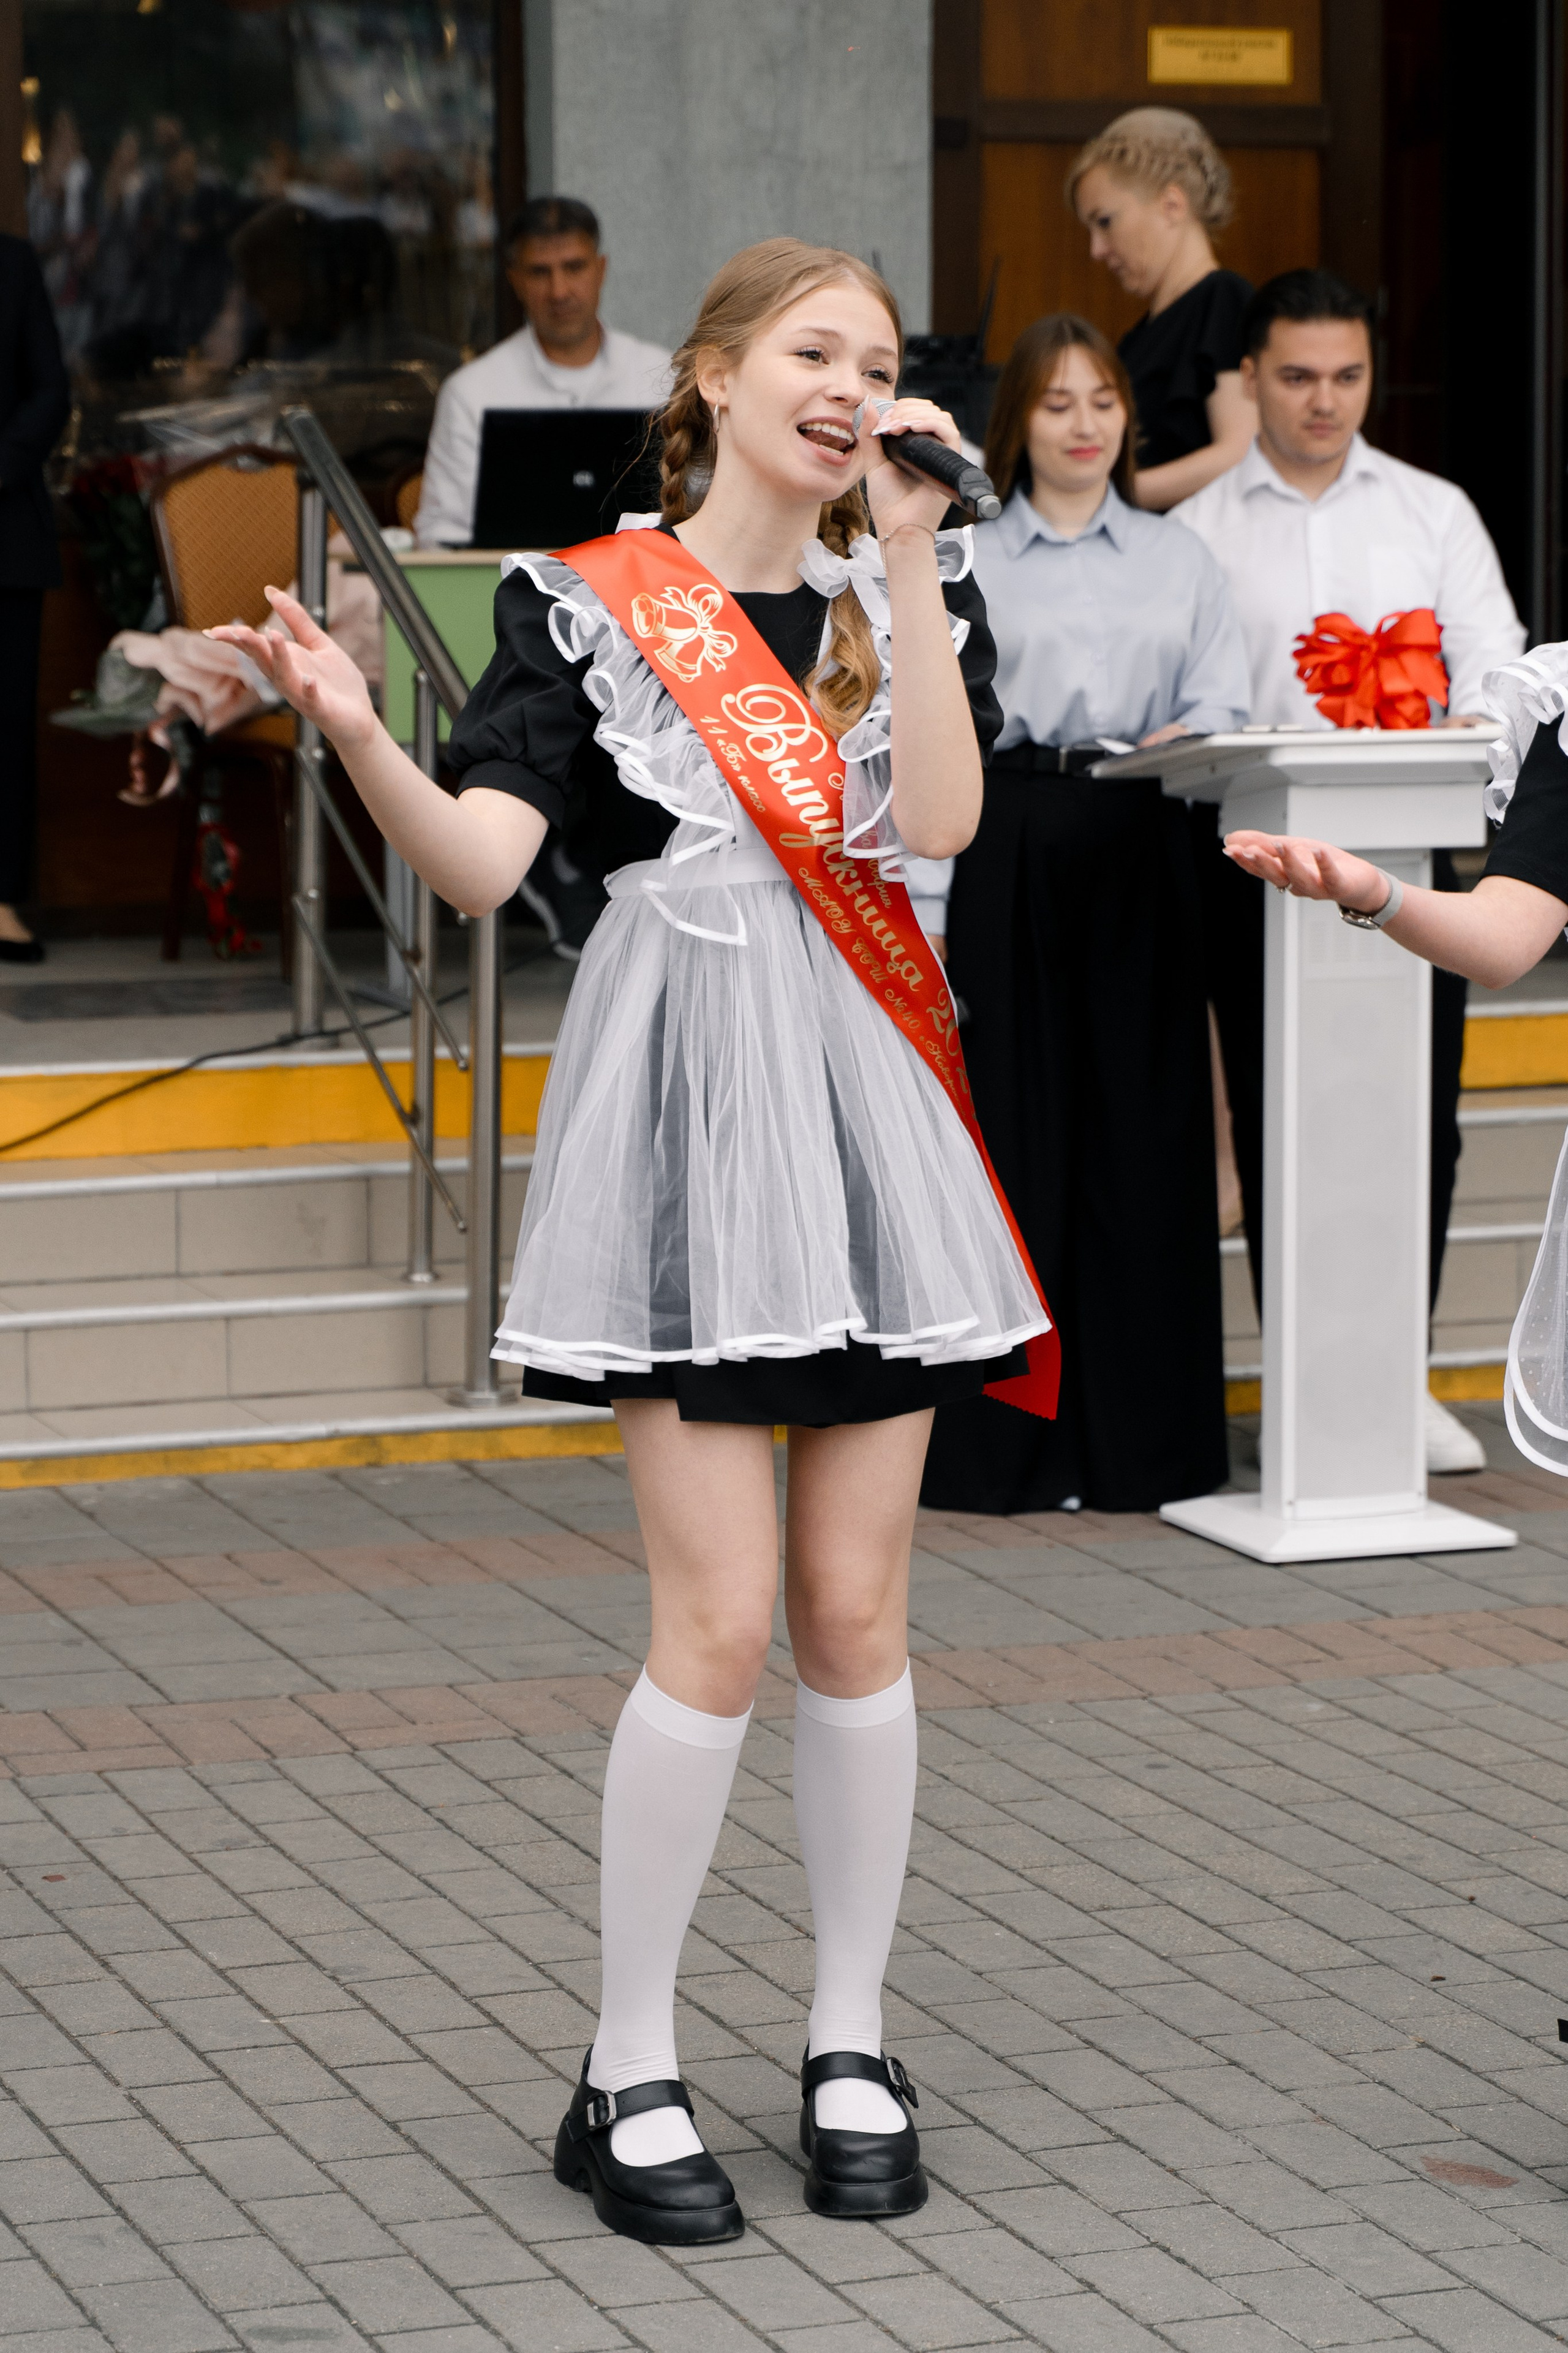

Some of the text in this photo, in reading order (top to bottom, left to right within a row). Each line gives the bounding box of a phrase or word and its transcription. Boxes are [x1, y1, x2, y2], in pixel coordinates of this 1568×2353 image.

[699, 716, 728, 734] 11
[737, 775, 766, 813] класс
[721, 683, 924, 992] Выпускница
[798, 867, 856, 934] МАОУ
[851, 937, 888, 984] СОШ
